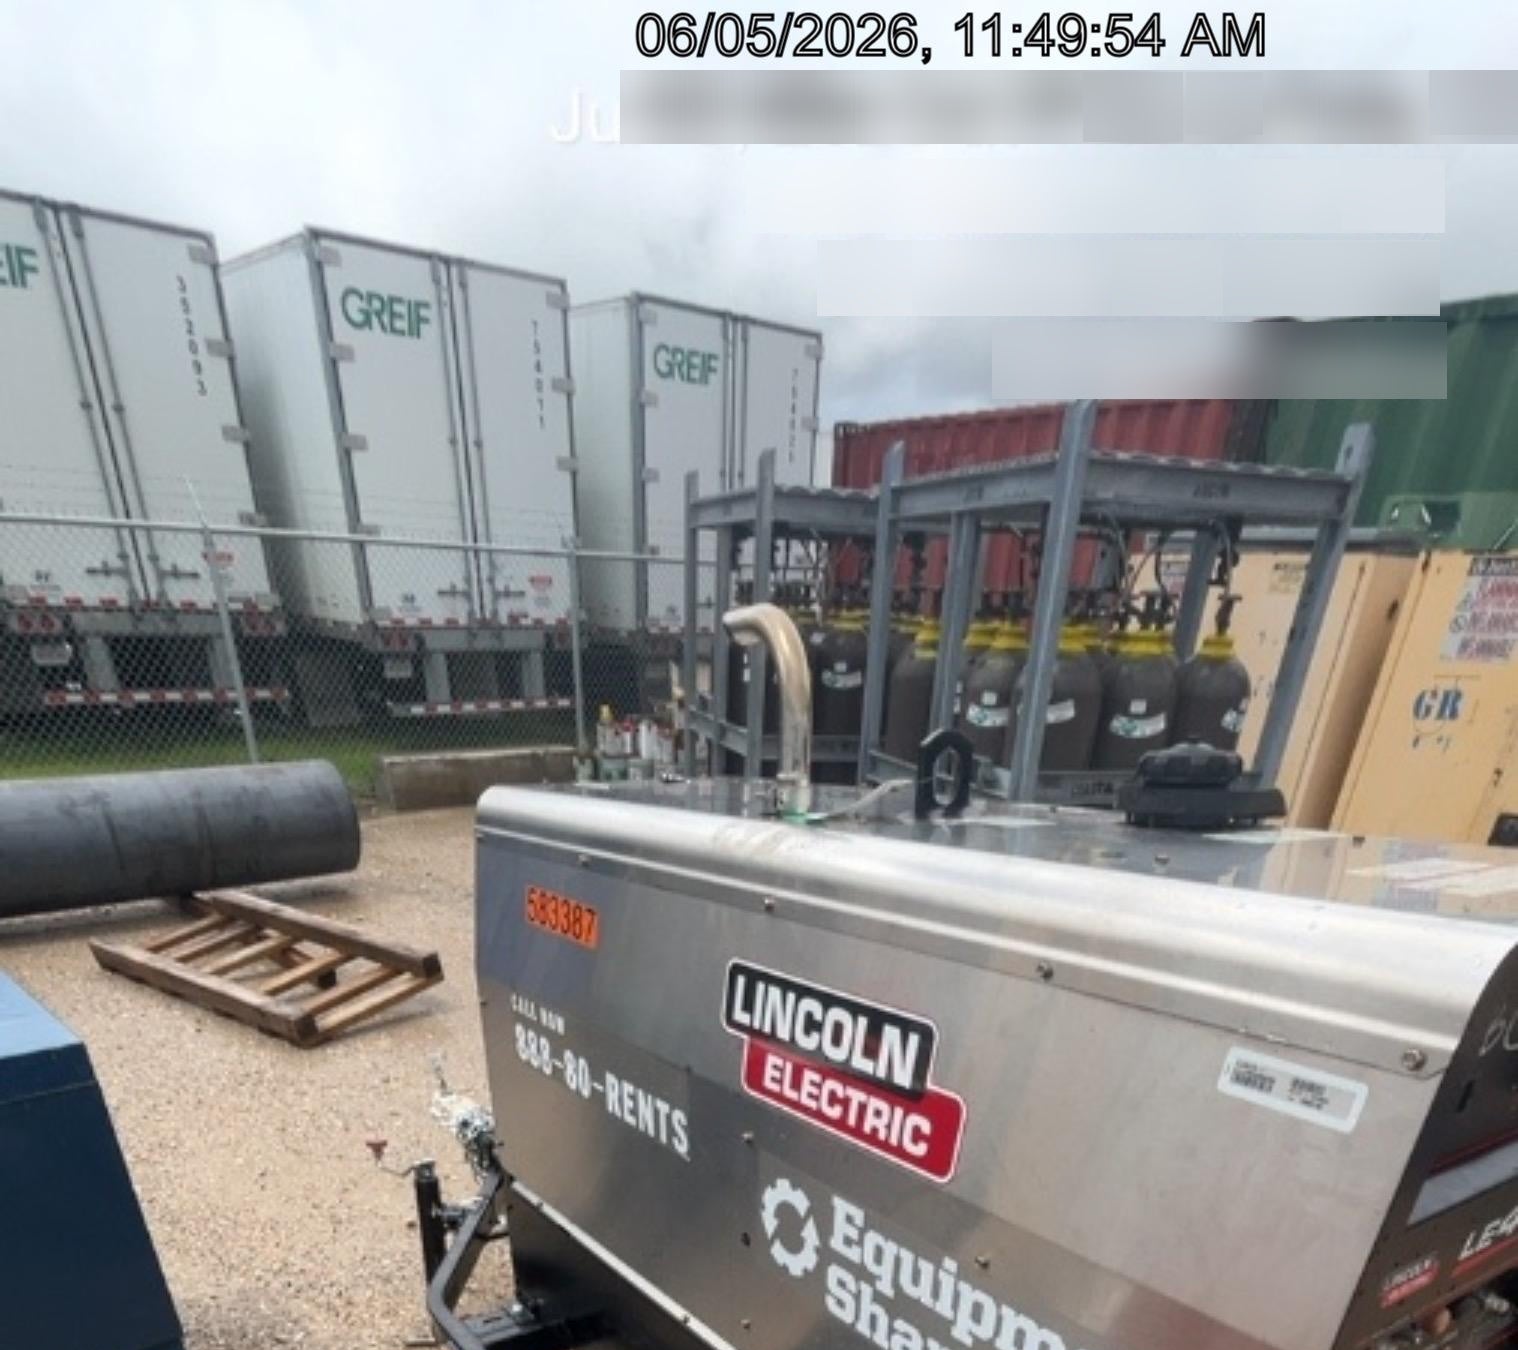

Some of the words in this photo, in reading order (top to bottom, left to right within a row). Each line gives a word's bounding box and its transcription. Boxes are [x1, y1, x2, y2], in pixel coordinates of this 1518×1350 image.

[340, 287, 432, 340] GREIF
[652, 343, 719, 386] GREIF
[527, 887, 597, 943] 583387
[510, 992, 537, 1021] CALL
[540, 1007, 565, 1036] NOW
[731, 975, 921, 1091] LINCOLN
[515, 1022, 689, 1156] 888-80-RENTS
[762, 1055, 931, 1156] ELECTRIC
